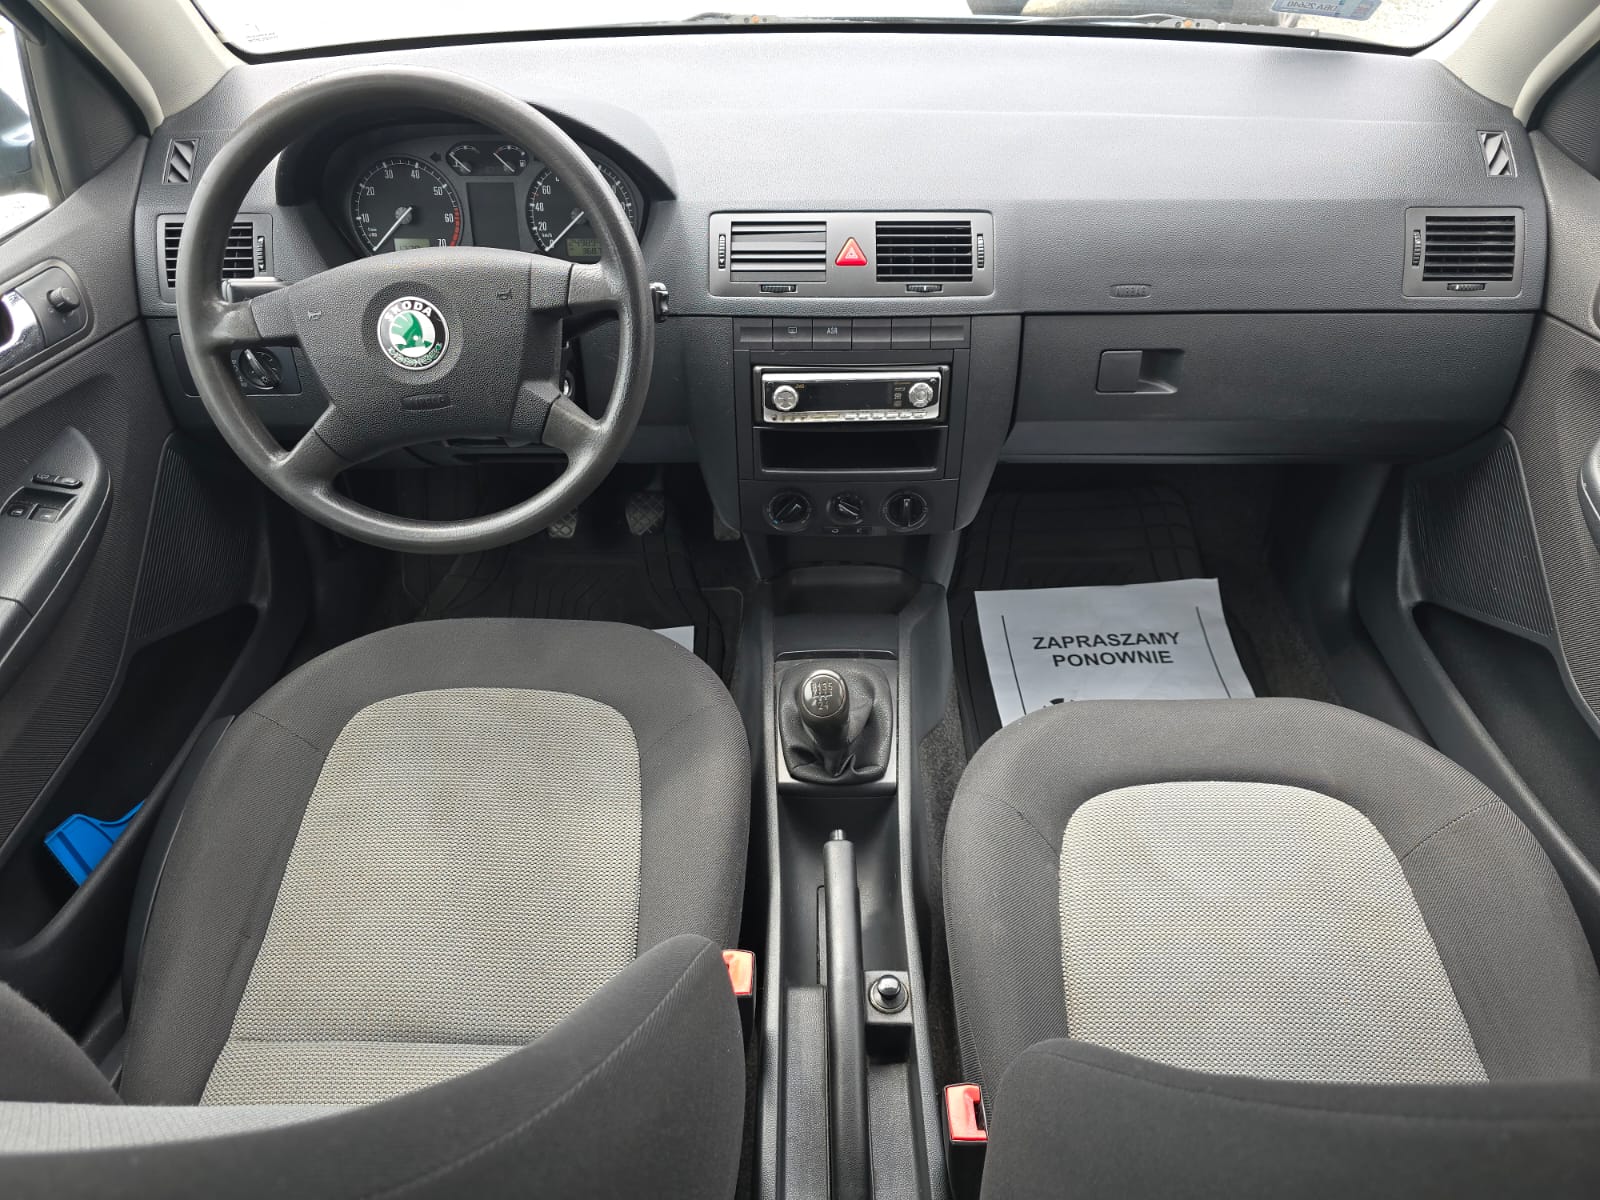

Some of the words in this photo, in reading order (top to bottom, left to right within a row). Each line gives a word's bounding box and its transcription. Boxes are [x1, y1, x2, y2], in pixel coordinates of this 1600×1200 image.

[384, 169, 394, 179] 30
[411, 169, 420, 179] 40
[366, 186, 375, 196] 20
[433, 186, 443, 196] 50
[541, 185, 551, 195] 60
[535, 202, 544, 212] 40
[361, 213, 370, 223] 10
[444, 213, 454, 223] 60
[538, 222, 547, 231] 20
[1032, 632, 1180, 649] ZAPRASZAMY
[1052, 651, 1174, 667] PONOWNIE
